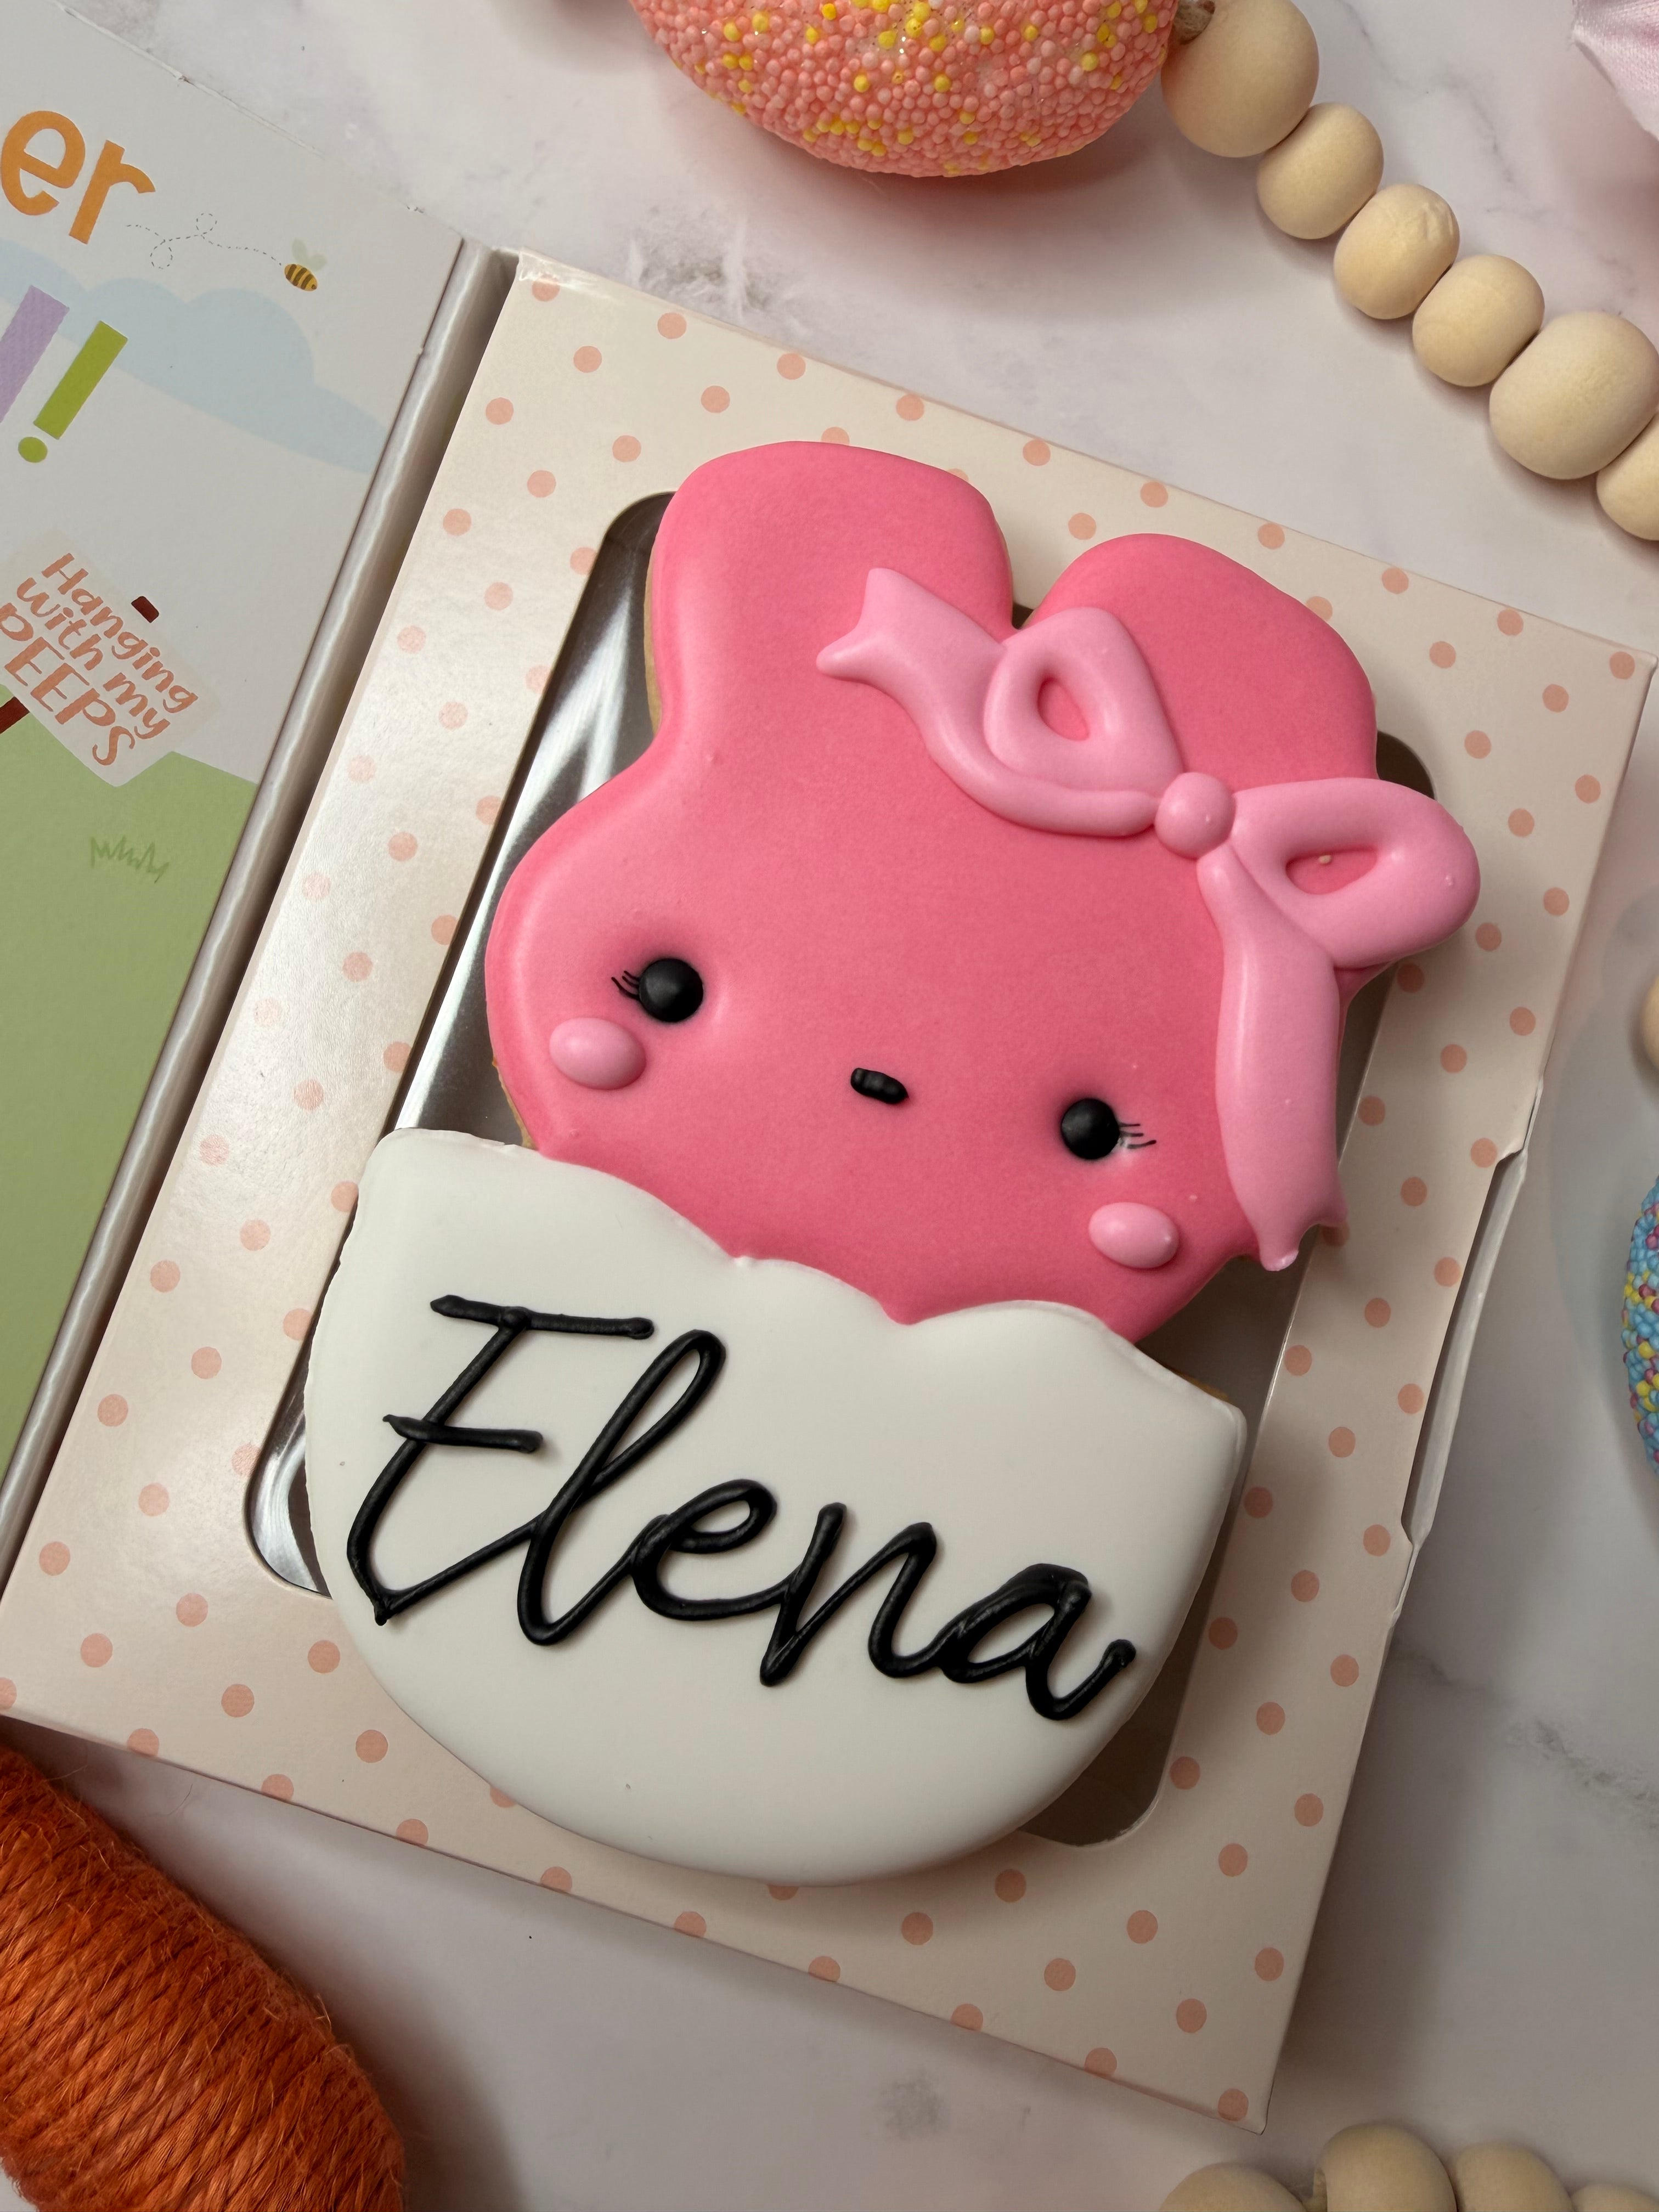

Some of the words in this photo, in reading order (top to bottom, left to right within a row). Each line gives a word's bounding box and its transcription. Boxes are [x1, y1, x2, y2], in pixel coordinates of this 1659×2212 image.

[0, 603, 135, 766] PEEPS
[42, 553, 198, 713] Hanging
[103, 673, 170, 740] my
[347, 1295, 1137, 1721] Elena
